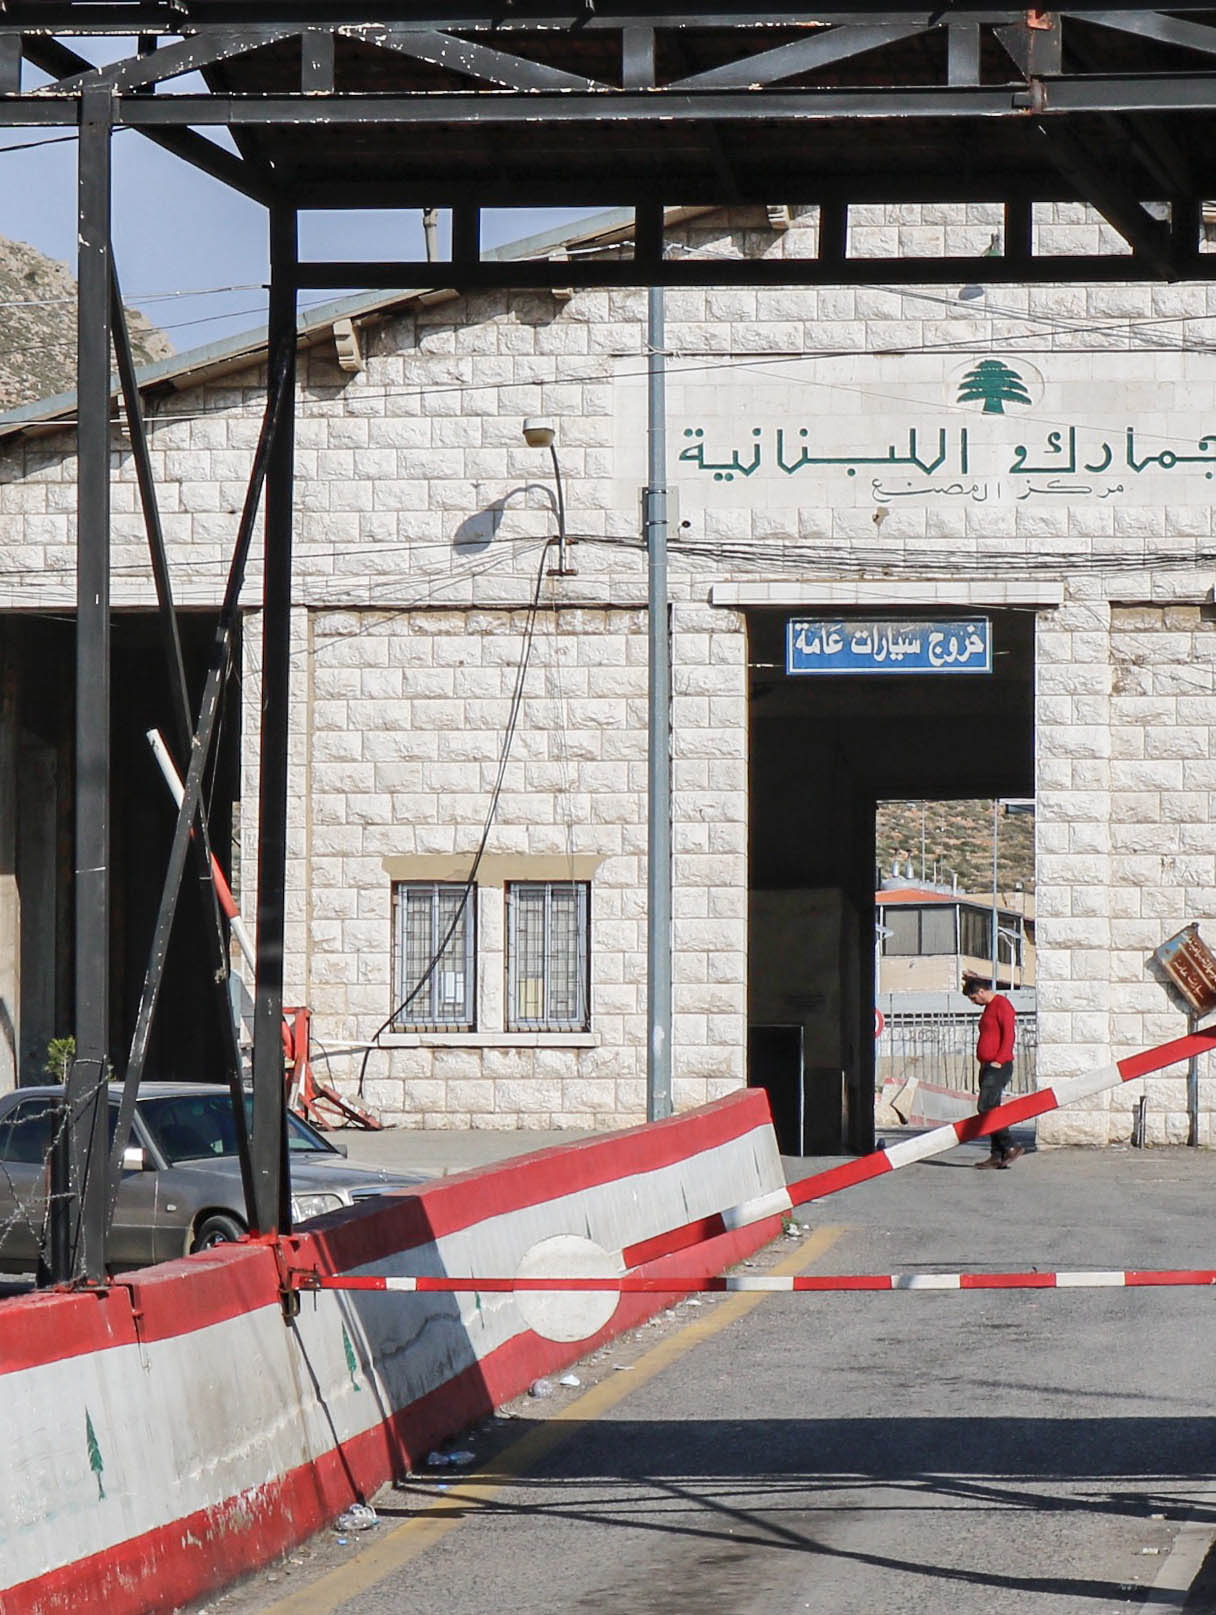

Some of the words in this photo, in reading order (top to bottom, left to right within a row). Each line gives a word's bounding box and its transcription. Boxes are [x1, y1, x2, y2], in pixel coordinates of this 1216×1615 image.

[679, 427, 967, 481] اللبنانية
[872, 478, 1000, 501] المصنع
[1016, 479, 1124, 499] مركز
[928, 625, 984, 666] خروج
